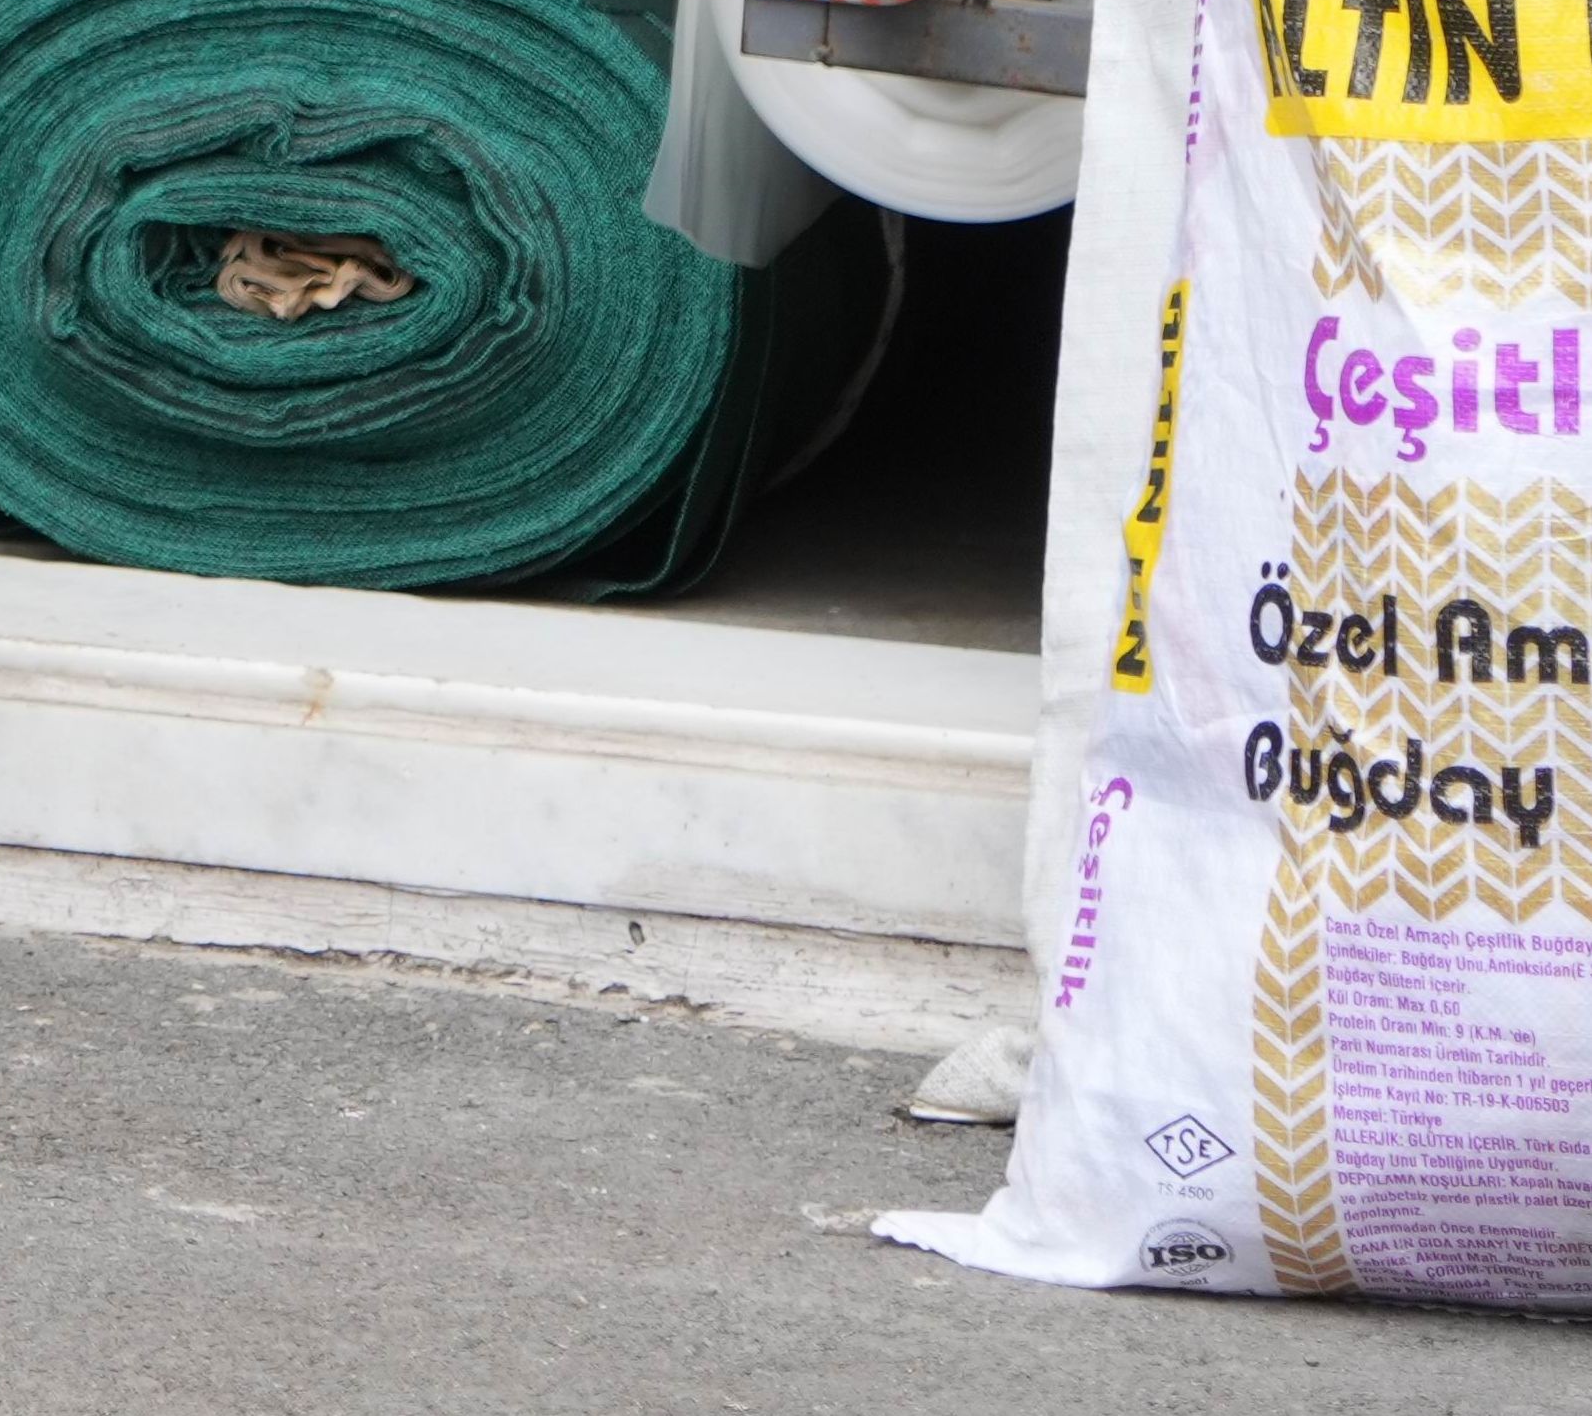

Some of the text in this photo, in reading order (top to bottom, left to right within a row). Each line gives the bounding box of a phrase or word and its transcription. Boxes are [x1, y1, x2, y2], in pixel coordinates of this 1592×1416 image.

[1304, 316, 1580, 462] Çeşitl
[1249, 561, 1590, 684] Özel Am
[1244, 720, 1555, 849] Buğday
[1326, 917, 1592, 957] Cana Özel Amaçlı Çeşitlik Buğday
[1401, 950, 1451, 972] Buğday
[1327, 965, 1374, 987] Buğday
[1379, 971, 1425, 990] Glüteni
[1328, 988, 1348, 1005] Kül
[1397, 996, 1425, 1012] Max
[1430, 999, 1460, 1017] 0,60
[1328, 1012, 1376, 1031] Protein
[1381, 1016, 1417, 1034] Oranı
[1455, 1024, 1464, 1039] 9
[1331, 1035, 1362, 1052] Parti
[1366, 1040, 1432, 1059] Numarası
[1436, 1042, 1482, 1064] Üretim
[1333, 1054, 1377, 1076] Üretim
[1381, 1063, 1453, 1083] Tarihinden
[1516, 1074, 1523, 1088] 1
[1529, 1075, 1546, 1092] yıl
[1386, 1086, 1420, 1105] Kayıt
[1424, 1090, 1448, 1105] No:
[1333, 1105, 1442, 1129] Menşei: Türkiye
[1163, 1128, 1212, 1164] TSE
[1408, 1130, 1463, 1150] GLÜTEN
[1524, 1137, 1555, 1153] Türk
[1558, 1140, 1591, 1155] Gıda
[1336, 1149, 1558, 1172] Buğday Unu Tebliğine Uygundur.
[1157, 1182, 1215, 1201] TS 4500
[1337, 1171, 1416, 1187] DEPOLAMA
[1420, 1174, 1506, 1190] KOŞULLARI:
[1510, 1175, 1553, 1190] Kapalı
[1341, 1194, 1357, 1205] ve
[1431, 1193, 1471, 1205] yerde
[1475, 1192, 1520, 1207] plastik
[1524, 1195, 1559, 1207] palet
[1346, 1222, 1436, 1238] Kullanmadan
[1440, 1221, 1475, 1234] Önce
[1148, 1244, 1227, 1268] ISO
[1349, 1240, 1390, 1255] CANA
[1417, 1237, 1454, 1249] GIDA
[1512, 1239, 1532, 1252] VE
